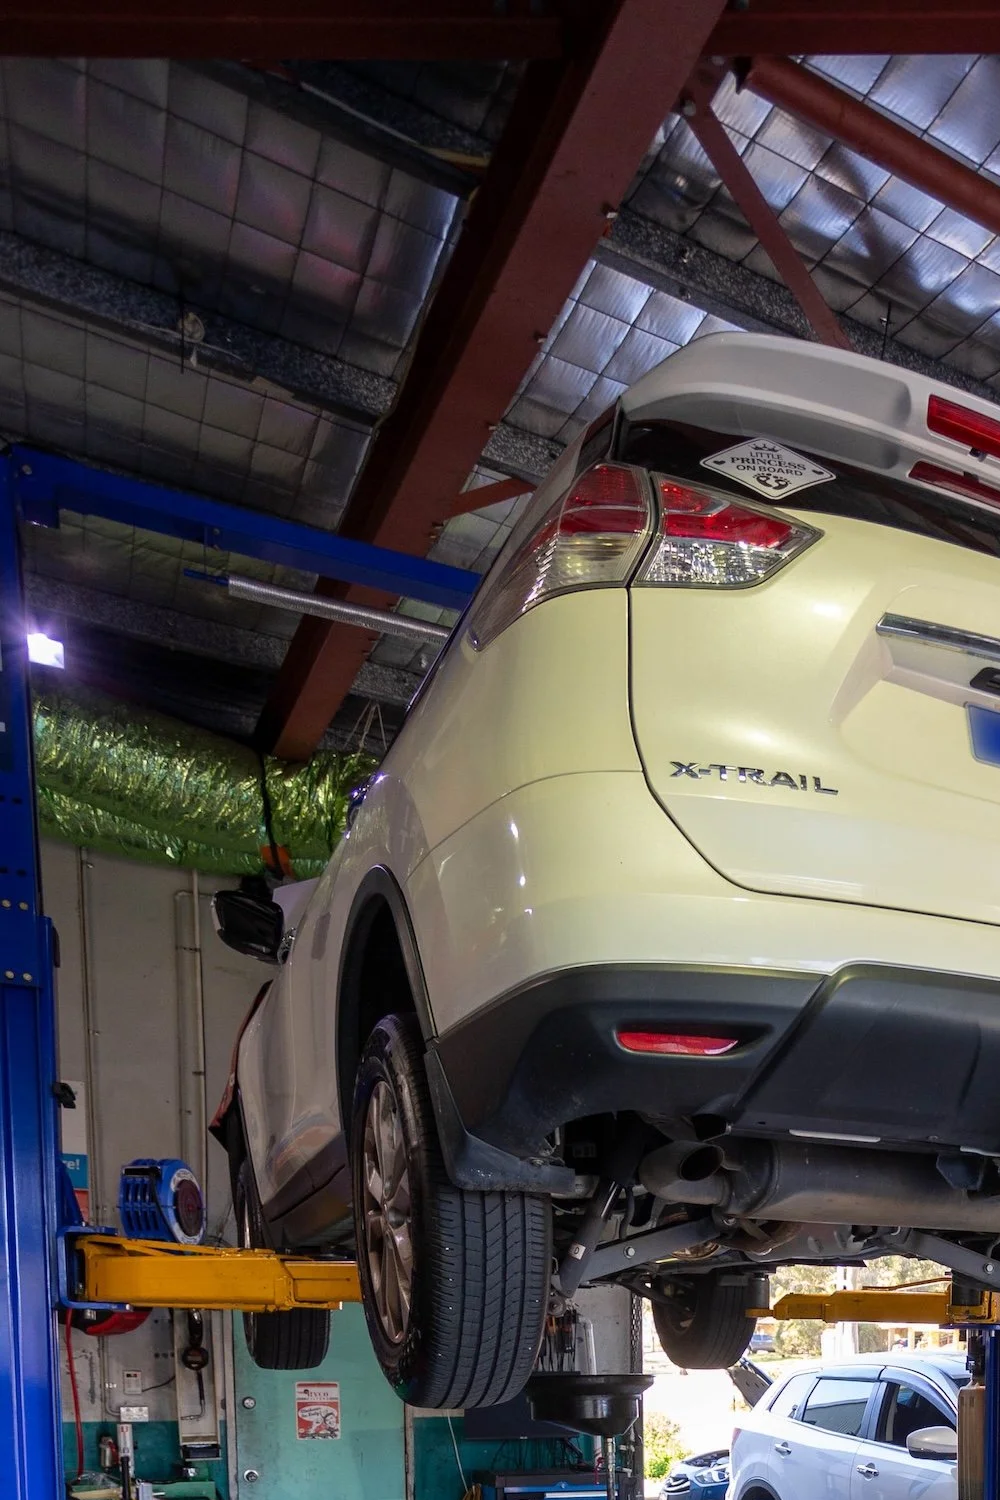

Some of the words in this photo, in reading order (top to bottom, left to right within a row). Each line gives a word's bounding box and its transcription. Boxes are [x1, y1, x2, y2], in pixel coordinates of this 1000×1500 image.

[749, 451, 783, 460] LITTLE
[730, 457, 806, 471] PRINCESS
[758, 465, 803, 476] BOARD
[669, 761, 839, 796] X-TRAIL
